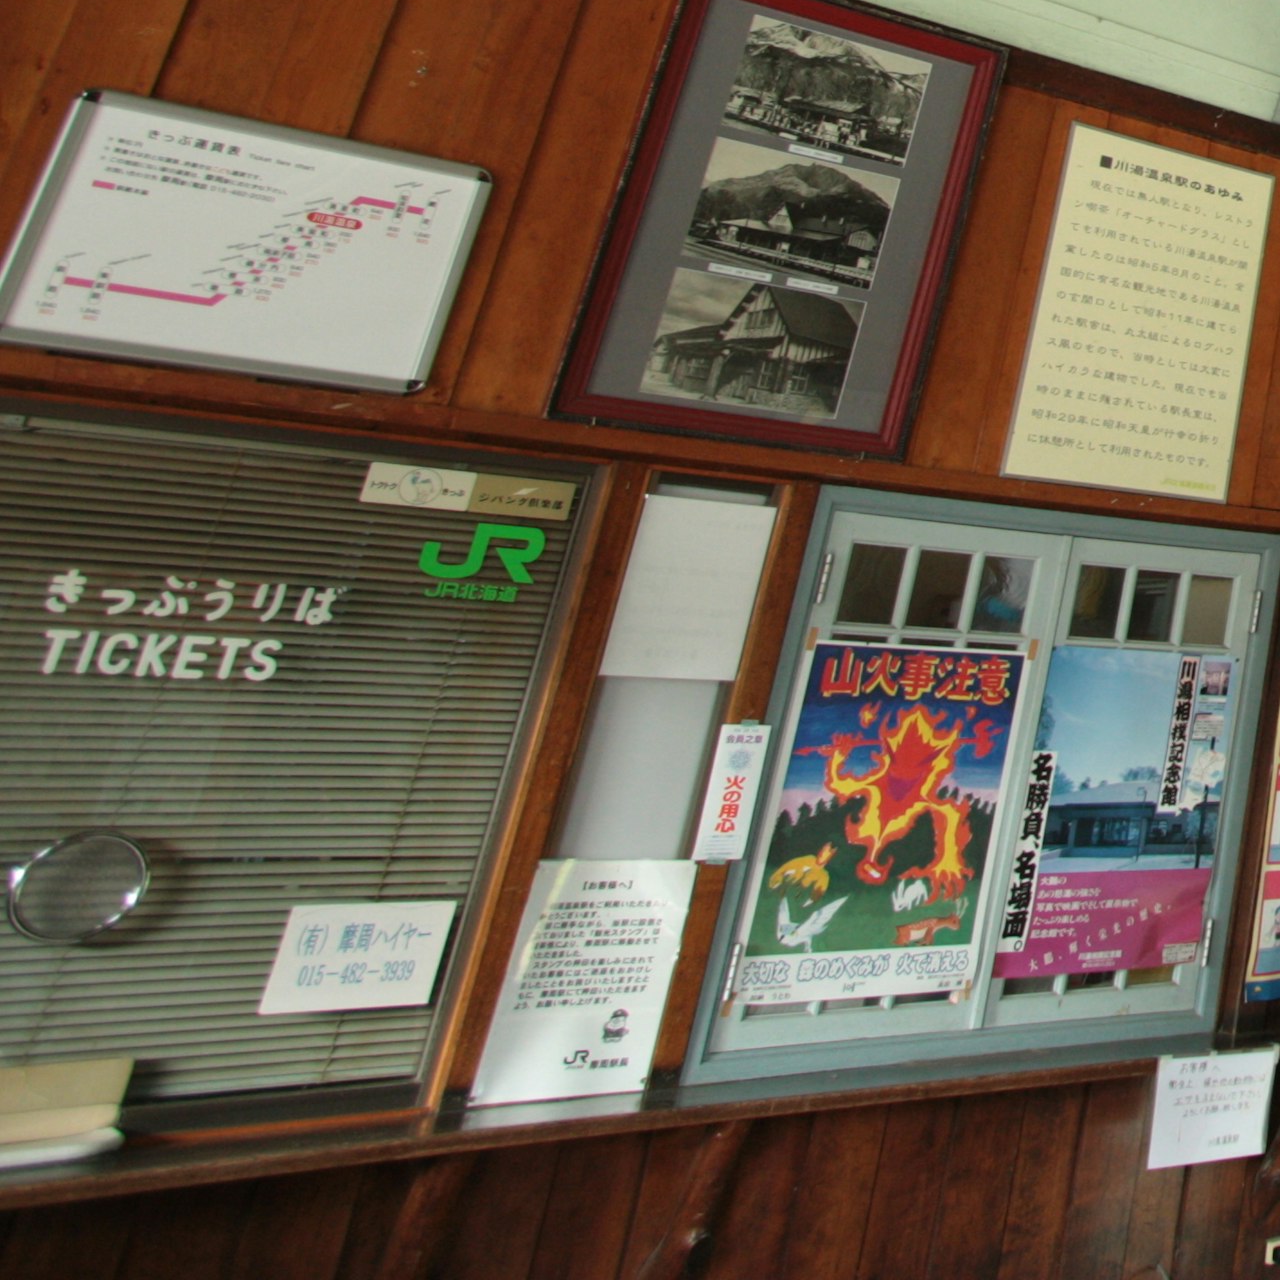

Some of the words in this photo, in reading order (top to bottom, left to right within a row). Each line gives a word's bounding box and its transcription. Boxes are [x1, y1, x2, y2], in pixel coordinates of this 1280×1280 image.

[1113, 158, 1245, 203] 川湯温泉駅のあゆみ
[418, 522, 546, 585] JR
[45, 568, 348, 626] きっぷうりば
[424, 581, 519, 603] JR北海道
[42, 629, 284, 682] TICKETS
[820, 646, 1011, 705] 山火事注意
[1160, 660, 1198, 807] 川湯相撲記念館
[714, 775, 747, 833] 火の用心
[1002, 752, 1054, 952] 名勝負、名場面。
[742, 959, 791, 986] 大切な
[896, 949, 970, 975] 火で消える
